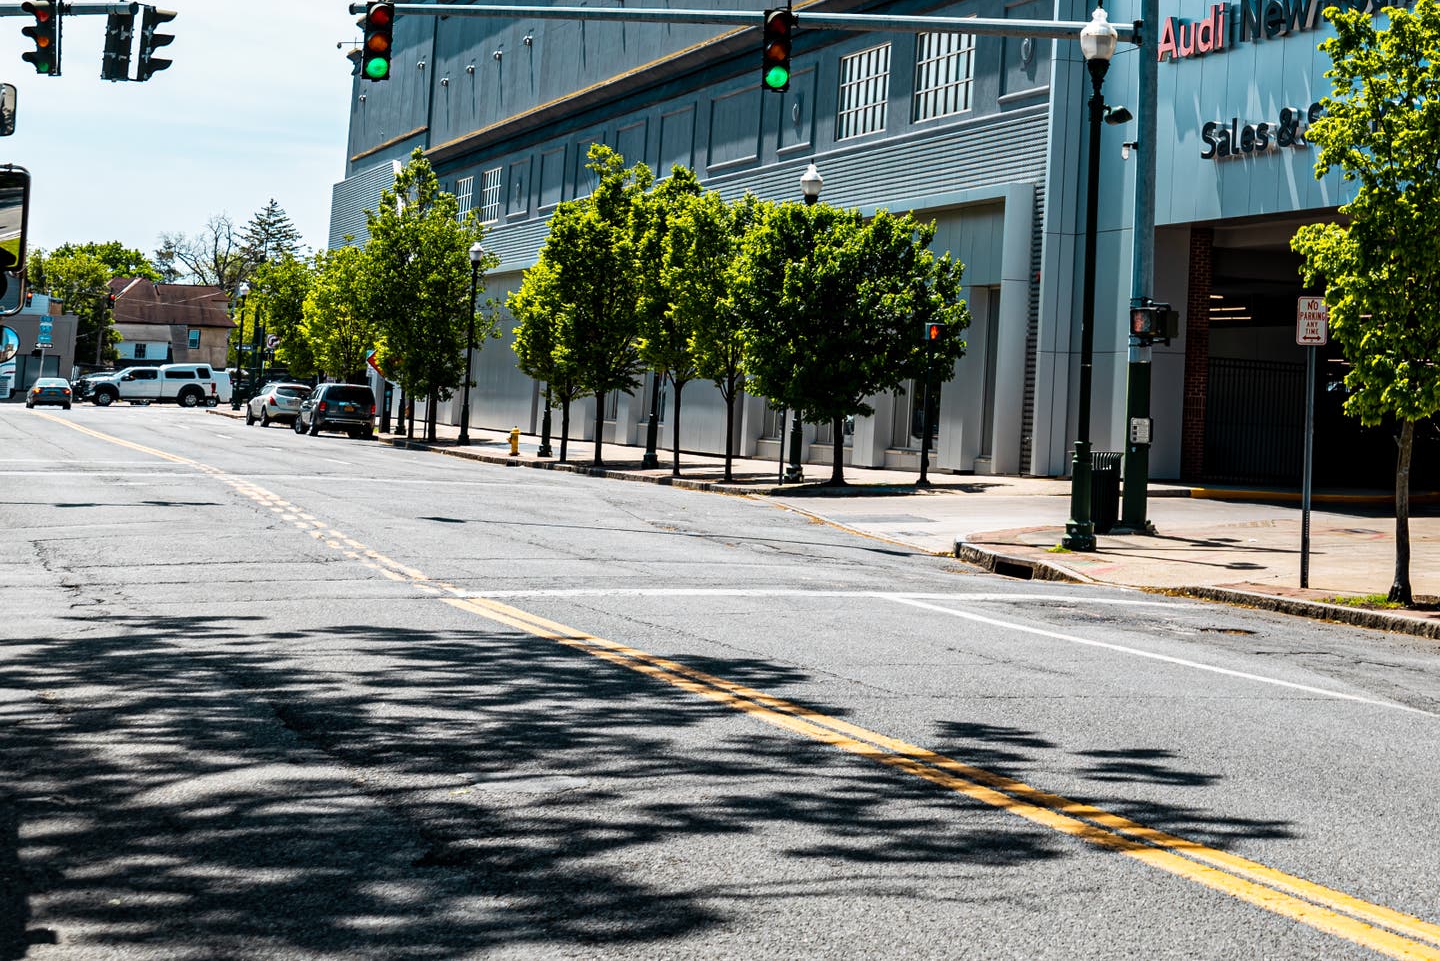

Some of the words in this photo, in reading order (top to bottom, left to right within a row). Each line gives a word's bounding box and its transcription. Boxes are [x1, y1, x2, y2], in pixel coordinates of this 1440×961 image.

[1158, 2, 1229, 62] Audi
[1201, 117, 1271, 159] Sales
[1277, 107, 1301, 148] &
[1300, 312, 1325, 321] PARKING
[1307, 301, 1319, 310] NO
